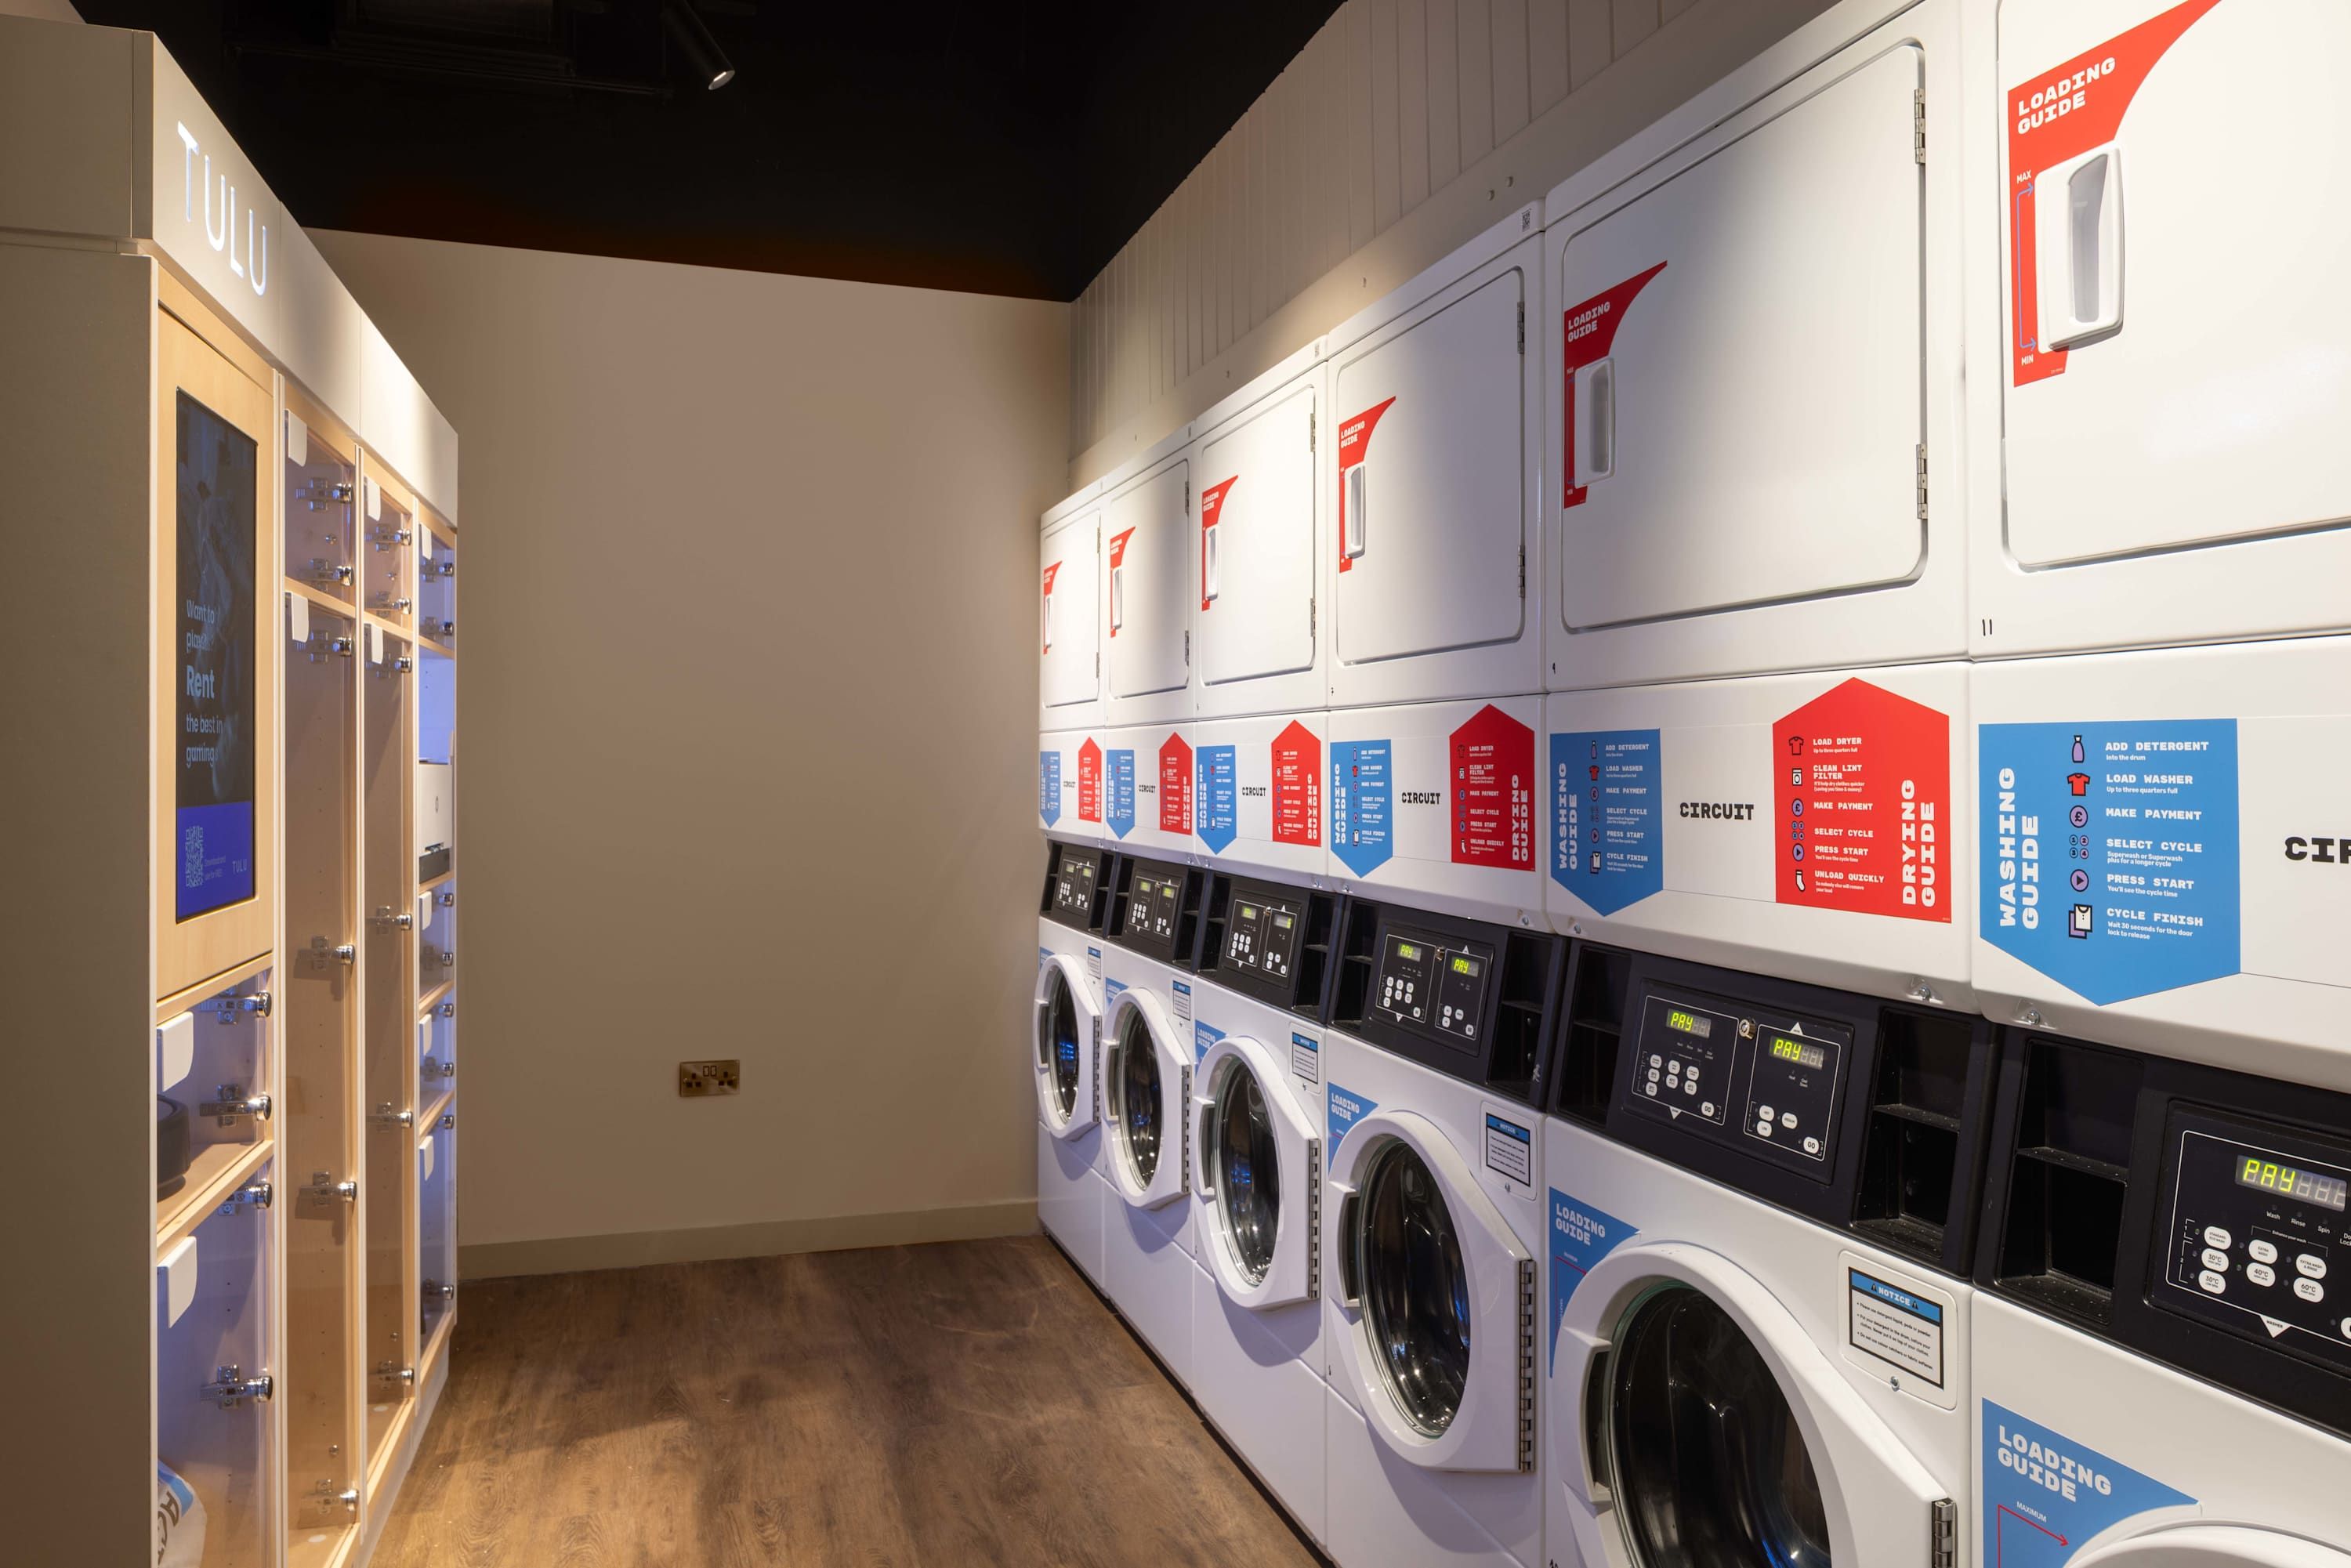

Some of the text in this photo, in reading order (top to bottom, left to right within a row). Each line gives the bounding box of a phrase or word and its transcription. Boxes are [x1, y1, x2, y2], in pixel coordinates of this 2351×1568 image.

[2018, 56, 2116, 116] LOADING
[2018, 90, 2085, 135] GUIDE
[2016, 170, 2031, 183] MAX
[177, 121, 267, 296] TULU
[1568, 302, 1610, 329] LOADING
[1567, 320, 1597, 342] GUIDE
[2022, 354, 2034, 365] MIN
[187, 599, 215, 624] Want to
[187, 664, 215, 699] Rent
[187, 713, 223, 734] the best in
[2106, 741, 2209, 751] ADD DETERGENT
[2106, 774, 2193, 784] LOAD WASHER
[1242, 787, 1266, 796] CIRCUIT
[1401, 791, 1440, 805] CIRCUIT
[1680, 802, 1755, 820] CIRCUIT
[1838, 802, 1873, 811] PAYMENT
[2106, 808, 2201, 820] MAKE PAYMENT
[1569, 794, 1578, 870] GUIDE
[1814, 827, 1873, 838] SELECT CYCLE
[1815, 846, 1868, 856] PRESS START
[1901, 780, 1917, 905] DRYING
[1999, 767, 2016, 927] WASHING
[2106, 838, 2202, 853] SELECT CYCLE
[1920, 802, 1936, 907] GUIDE
[2107, 851, 2140, 860] Superwash
[1815, 870, 1885, 883] UNLOAD QUICKLY
[2022, 815, 2038, 930] GUIDE
[2107, 875, 2194, 889] PRESS START
[2106, 908, 2204, 926] CYCLE FINISH
[2130, 924, 2155, 932] seconds
[1400, 945, 1414, 958] PAY
[1454, 958, 1469, 973] PAY
[1670, 1012, 1694, 1031] PAY
[1773, 1039, 1802, 1060] PAY
[1331, 1092, 1360, 1113] LOADING
[1331, 1103, 1352, 1121] GUIDE
[2242, 1159, 2296, 1193] PAY
[1556, 1203, 1606, 1238] LOADING
[2266, 1211, 2330, 1234] Wash Rinse Spin
[1556, 1218, 1591, 1246] GUIDE
[2208, 1254, 2222, 1262] 30°C
[2205, 1275, 2219, 1284] 30°C
[2254, 1269, 2268, 1277] 40°C
[1878, 1287, 1911, 1306] NOTICE
[2301, 1284, 2316, 1293] 60°C
[1998, 1425, 2111, 1497] LOADING
[1998, 1447, 2077, 1503] GUIDE
[2016, 1501, 2047, 1523] MAXIMUM
